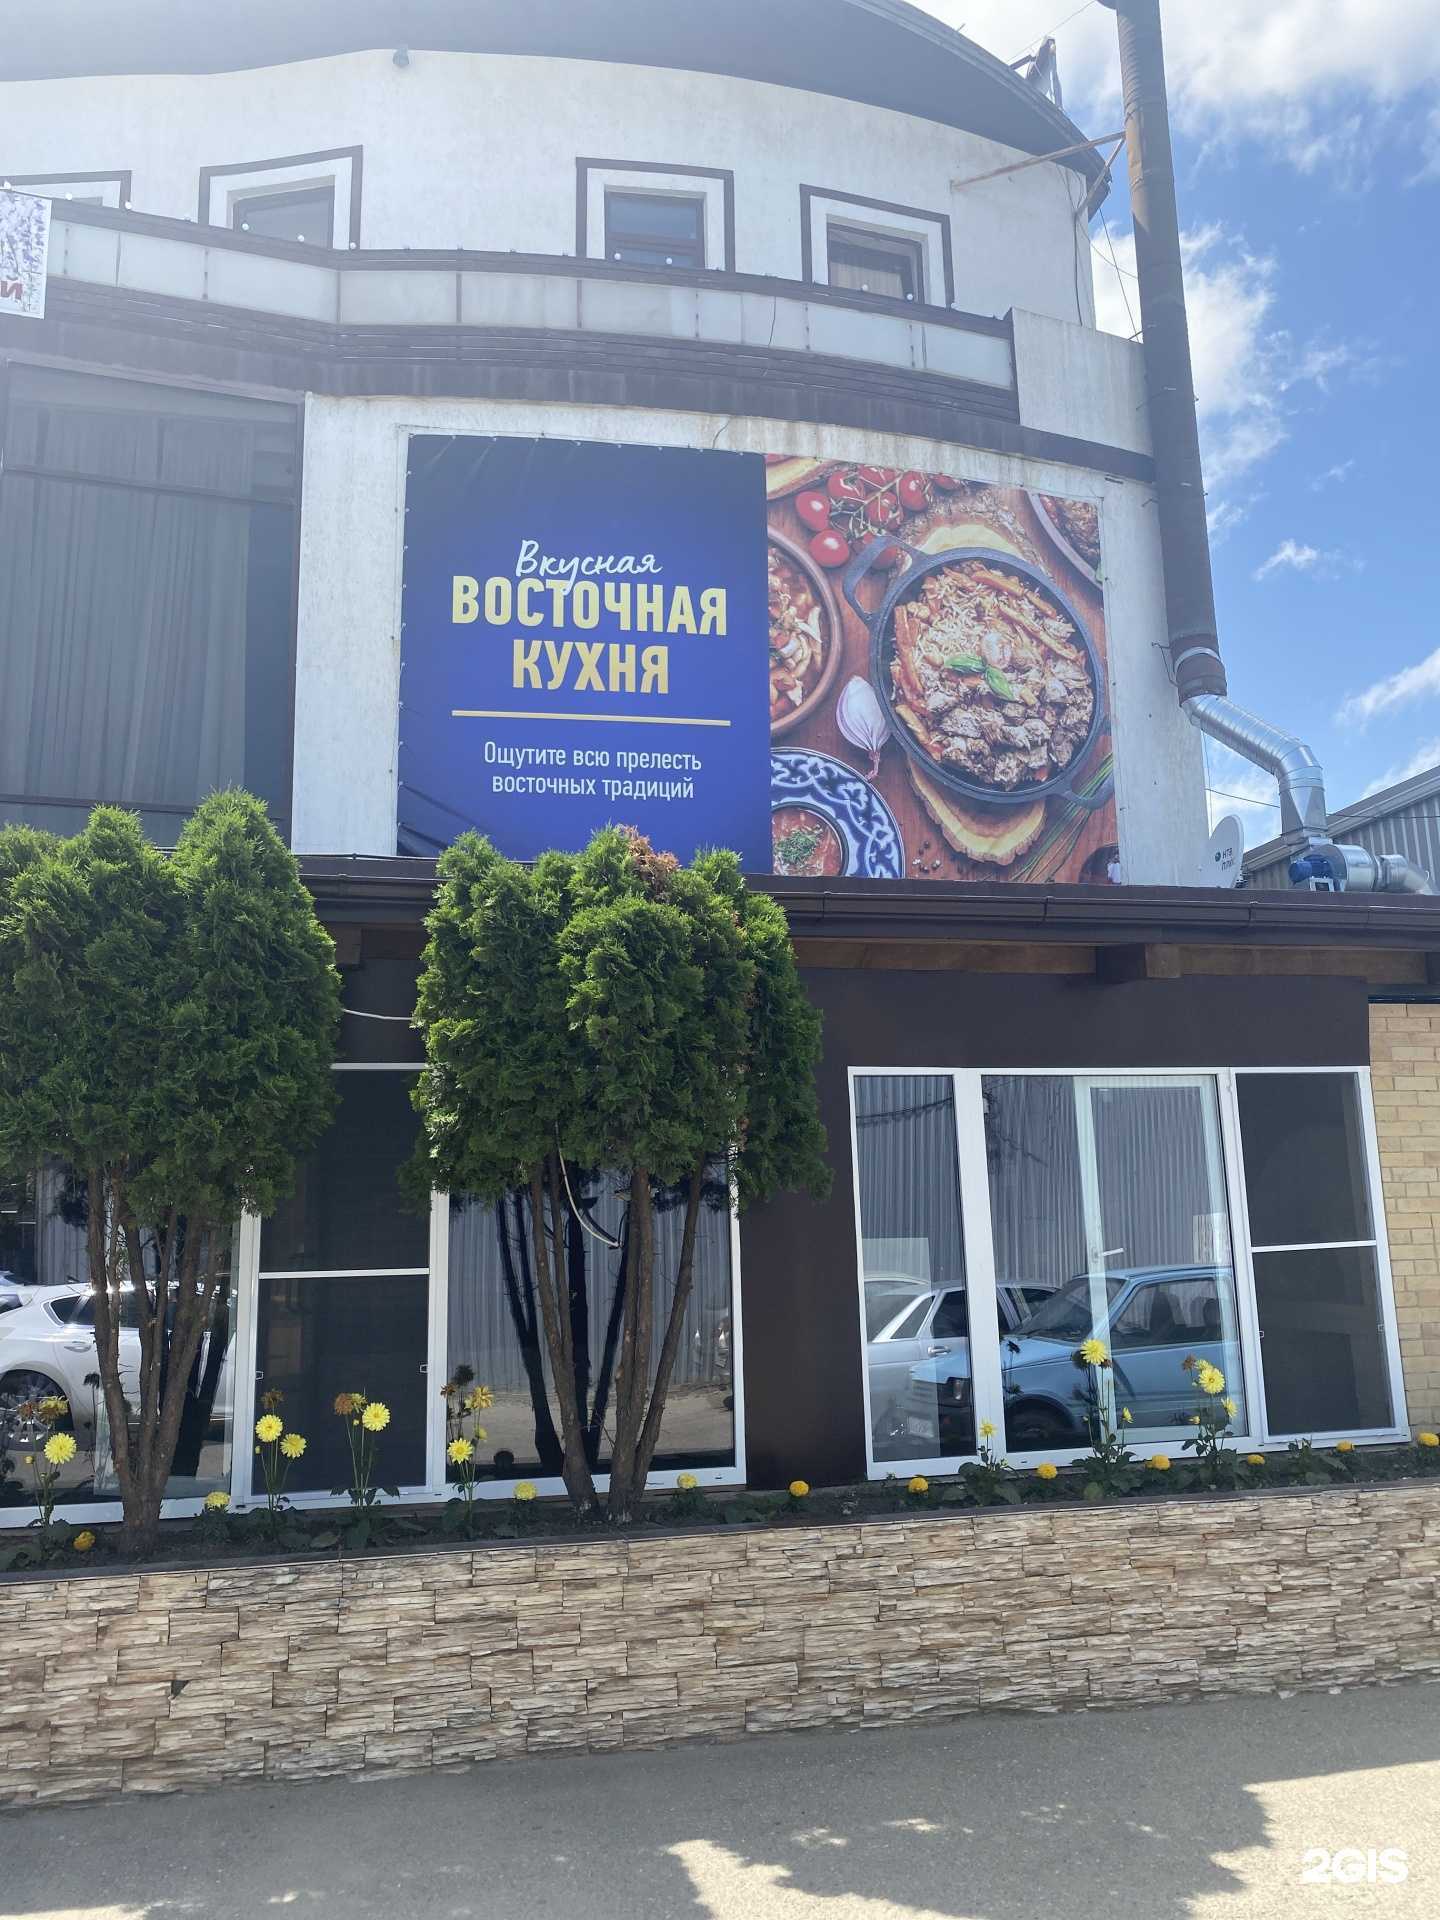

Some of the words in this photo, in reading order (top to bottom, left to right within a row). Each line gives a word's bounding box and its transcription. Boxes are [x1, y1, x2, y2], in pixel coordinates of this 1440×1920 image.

[515, 539, 663, 596] Вкусная
[451, 575, 728, 636] ВОСТОЧНАЯ
[512, 639, 669, 695] КУХНЯ
[484, 741, 566, 769] Ощутите
[573, 750, 611, 767] всю
[616, 751, 702, 773] прелесть
[492, 776, 596, 796] восточных
[602, 777, 695, 801] традиций
